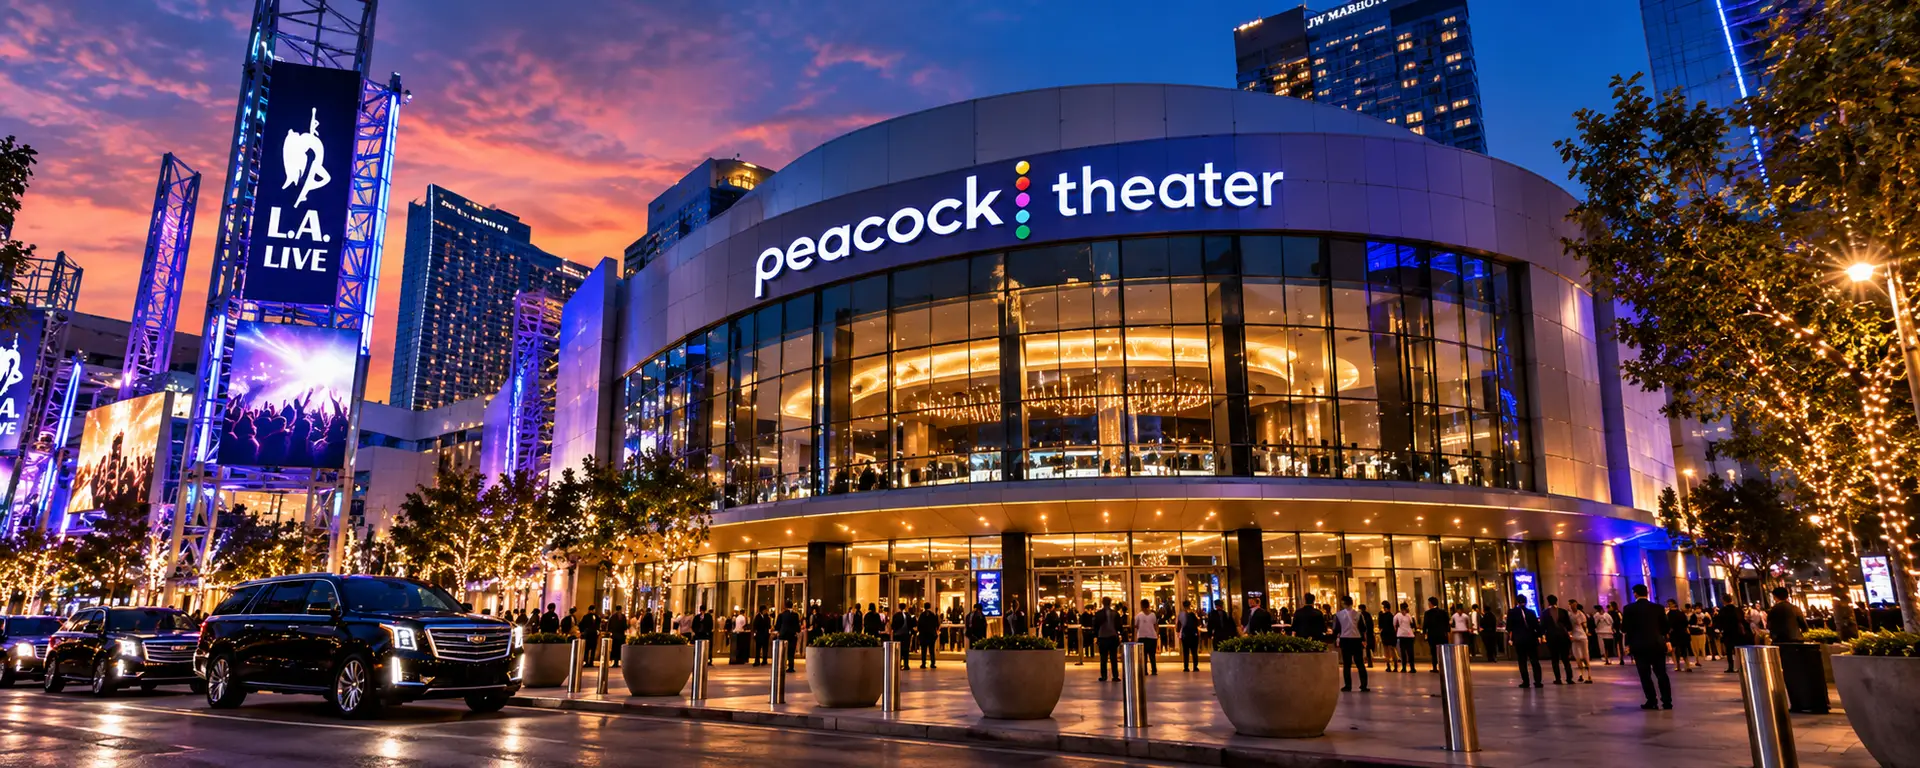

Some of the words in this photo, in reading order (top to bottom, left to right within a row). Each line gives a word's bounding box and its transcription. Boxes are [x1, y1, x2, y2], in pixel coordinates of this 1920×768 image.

[1306, 14, 1326, 29] JW
[267, 206, 331, 243] L.A.
[754, 175, 1004, 299] peacock
[1052, 162, 1284, 217] theater
[263, 245, 328, 272] LIVE
[0, 397, 20, 419] A.
[0, 421, 17, 436] VE
